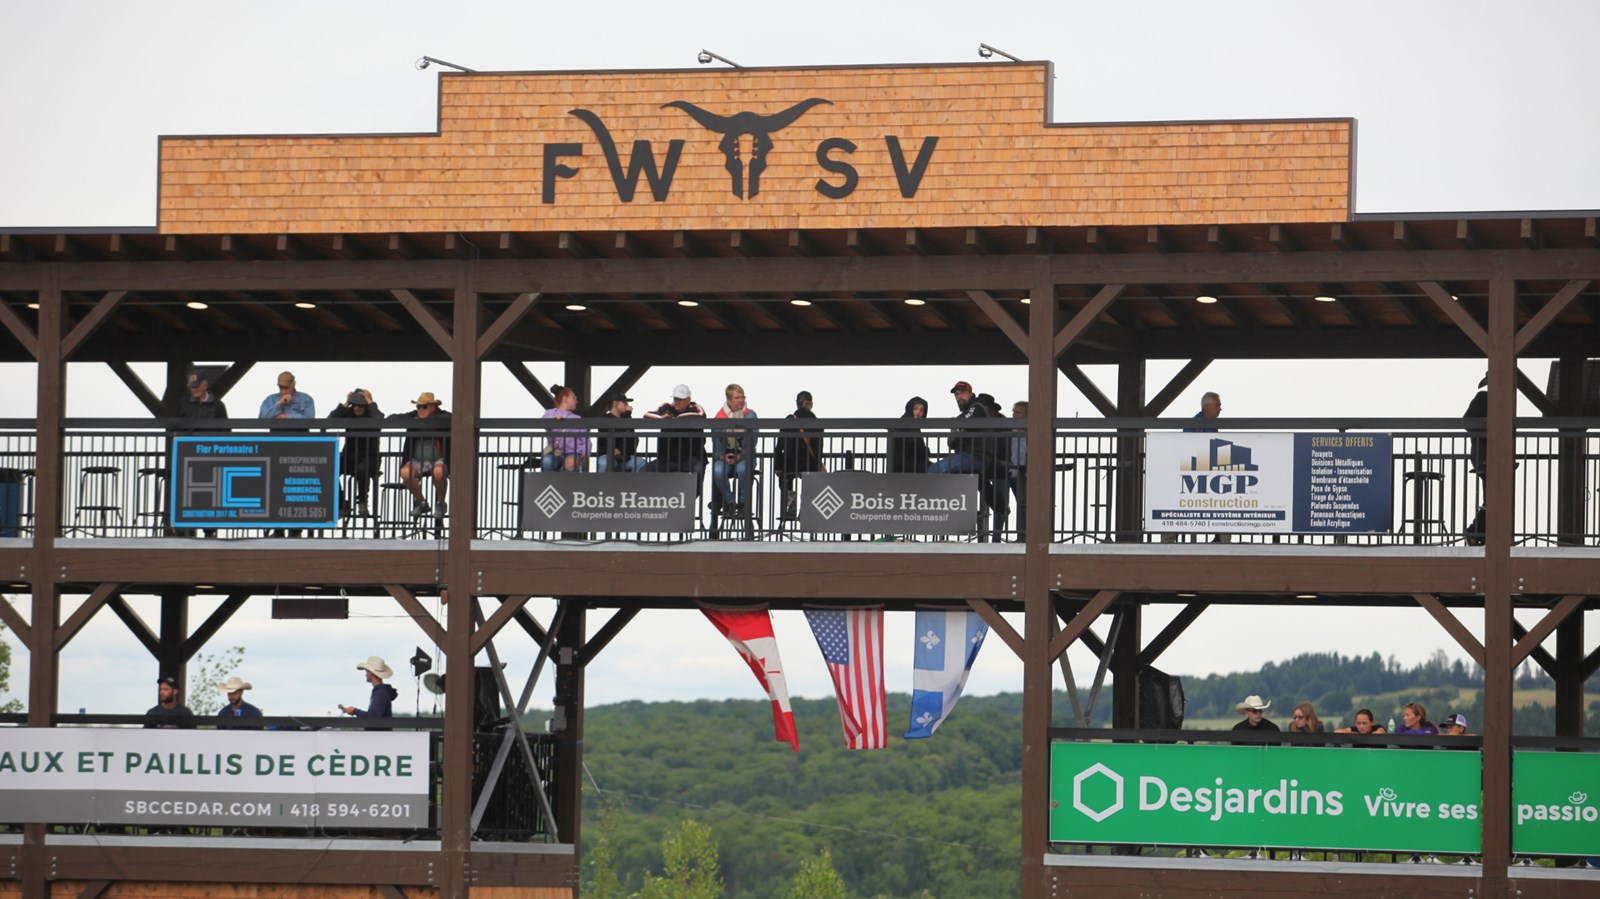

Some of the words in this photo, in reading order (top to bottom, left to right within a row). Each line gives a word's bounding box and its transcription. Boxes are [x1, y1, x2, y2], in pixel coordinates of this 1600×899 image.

[1312, 437, 1343, 447] SERVICES
[1345, 437, 1374, 447] OFFERTS
[196, 444, 211, 454] Fier
[213, 444, 253, 454] Partenaire
[1311, 450, 1333, 458] Parapets
[279, 456, 327, 464] ENTREPRENEUR
[1311, 458, 1334, 466] Divisions
[1335, 458, 1364, 468] Métalliques
[288, 465, 317, 473] GÉNÉRAL
[1311, 467, 1333, 475] Isolation
[1337, 467, 1373, 475] Insonorisation
[284, 477, 321, 485] RÉSIDENTIEL
[1180, 474, 1259, 495] MGP
[1311, 476, 1337, 484] Membrane
[283, 486, 322, 494] COMMERCIAL
[1332, 485, 1348, 494] Gypse
[572, 491, 615, 509] Bois
[620, 491, 686, 509] Hamel
[850, 492, 894, 510] Bois
[899, 493, 967, 511] Hamel
[1311, 493, 1327, 502] Tirage
[1327, 493, 1334, 501] de
[1335, 493, 1352, 501] Joints
[1179, 497, 1259, 509] construction
[1311, 502, 1332, 510] Plafonds
[1333, 502, 1360, 511] Suspendus
[572, 511, 612, 520] Charpente
[624, 511, 641, 519] bois
[850, 512, 891, 522] Charpente
[904, 513, 921, 521] bois
[922, 513, 949, 521] massif
[1335, 511, 1365, 519] Acoustiques
[1310, 519, 1326, 527] Enduit
[1327, 519, 1351, 528] Acrylique
[0, 751, 64, 773] AUX
[78, 752, 114, 773] ET
[125, 753, 243, 776] PAILLIS
[255, 754, 295, 777] DE
[307, 749, 413, 777] CÈDRE
[1139, 775, 1344, 821] Desjardins
[124, 800, 272, 817] SBCCEDAR.COM
[290, 802, 320, 817] 418
[327, 803, 411, 818] 594-6201
[1363, 794, 1431, 819] Vivre
[1438, 801, 1478, 821] ses
[1517, 804, 1599, 825] passio
